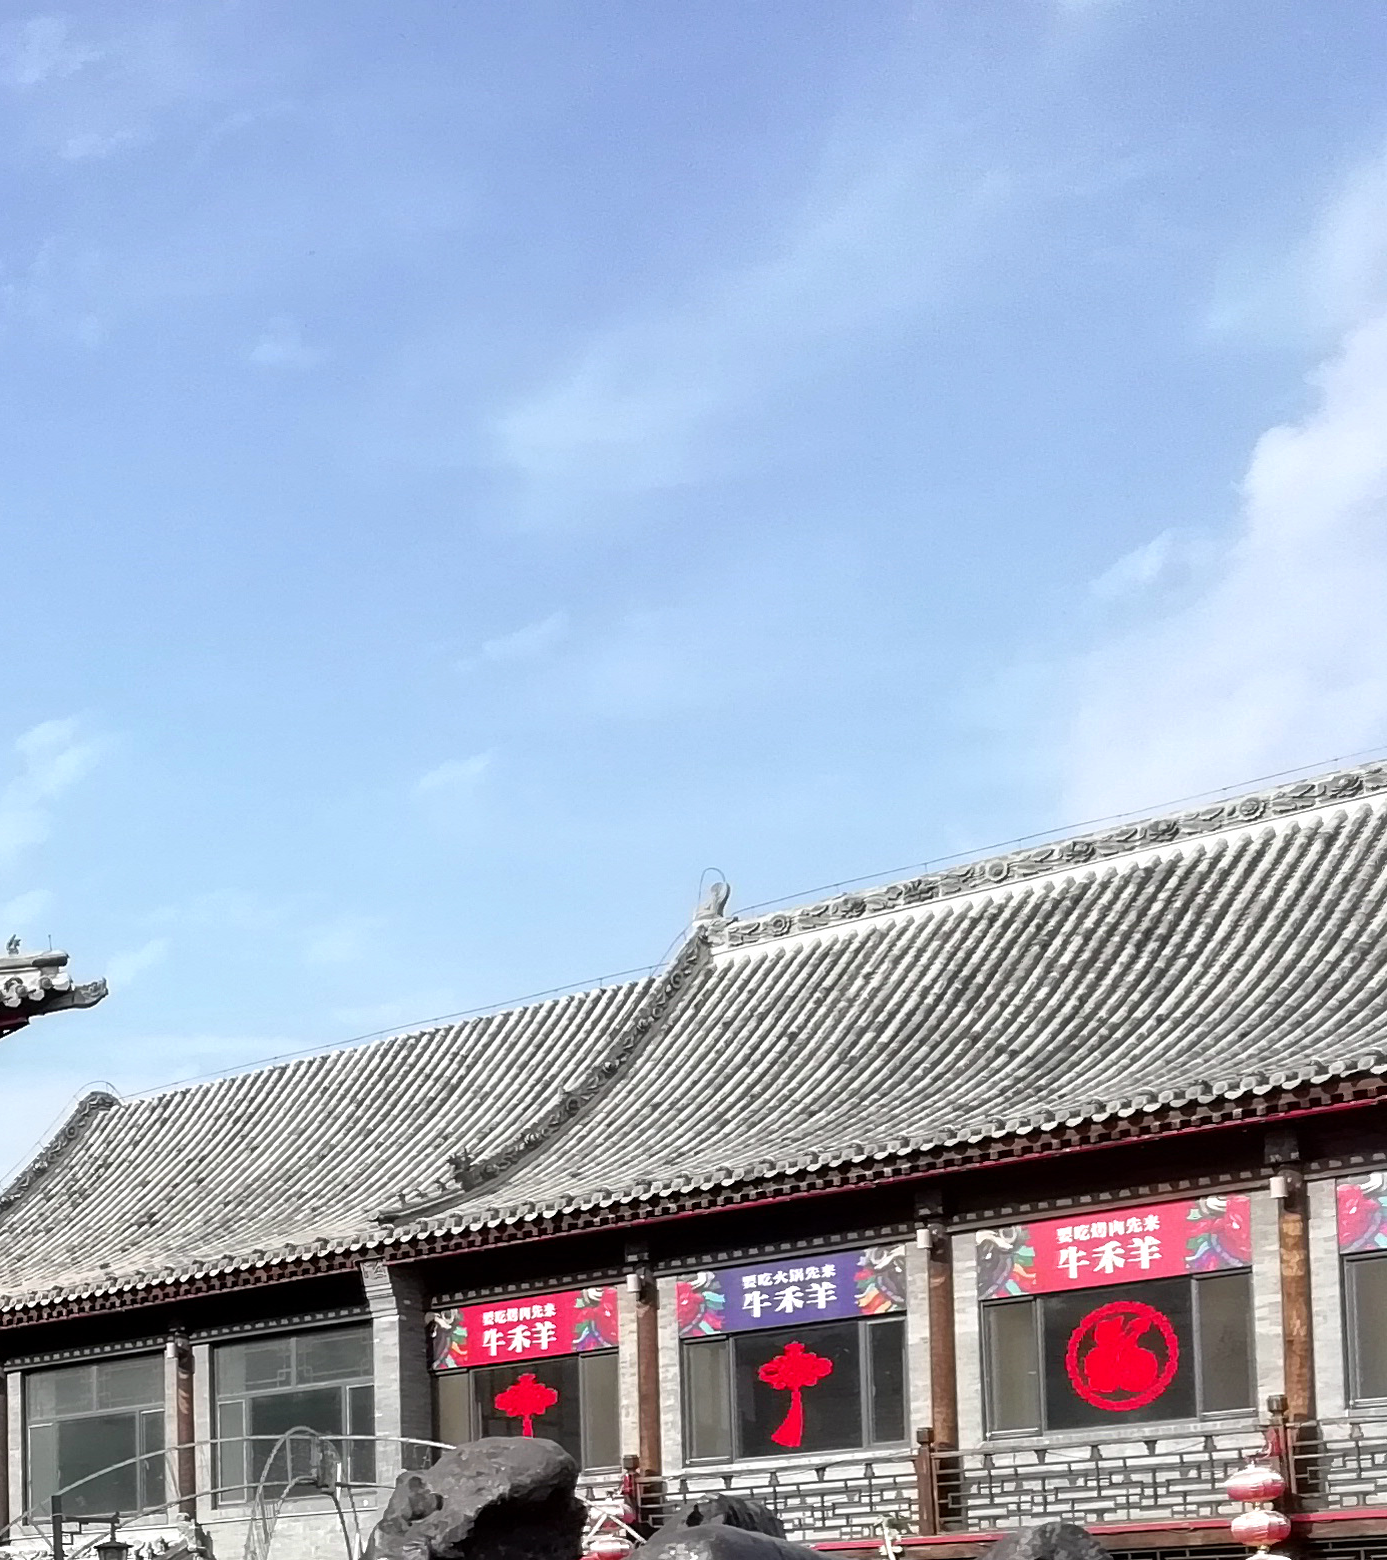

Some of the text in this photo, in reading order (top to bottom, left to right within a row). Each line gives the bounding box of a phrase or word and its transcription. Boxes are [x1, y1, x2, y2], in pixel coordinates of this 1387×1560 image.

[1056, 1214, 1161, 1244] 要吃烤肉先来
[1056, 1235, 1163, 1279] 牛禾羊
[741, 1264, 837, 1290] 要吃火锅先来
[741, 1281, 838, 1318] 牛禾羊
[481, 1320, 558, 1357] 牛禾羊
